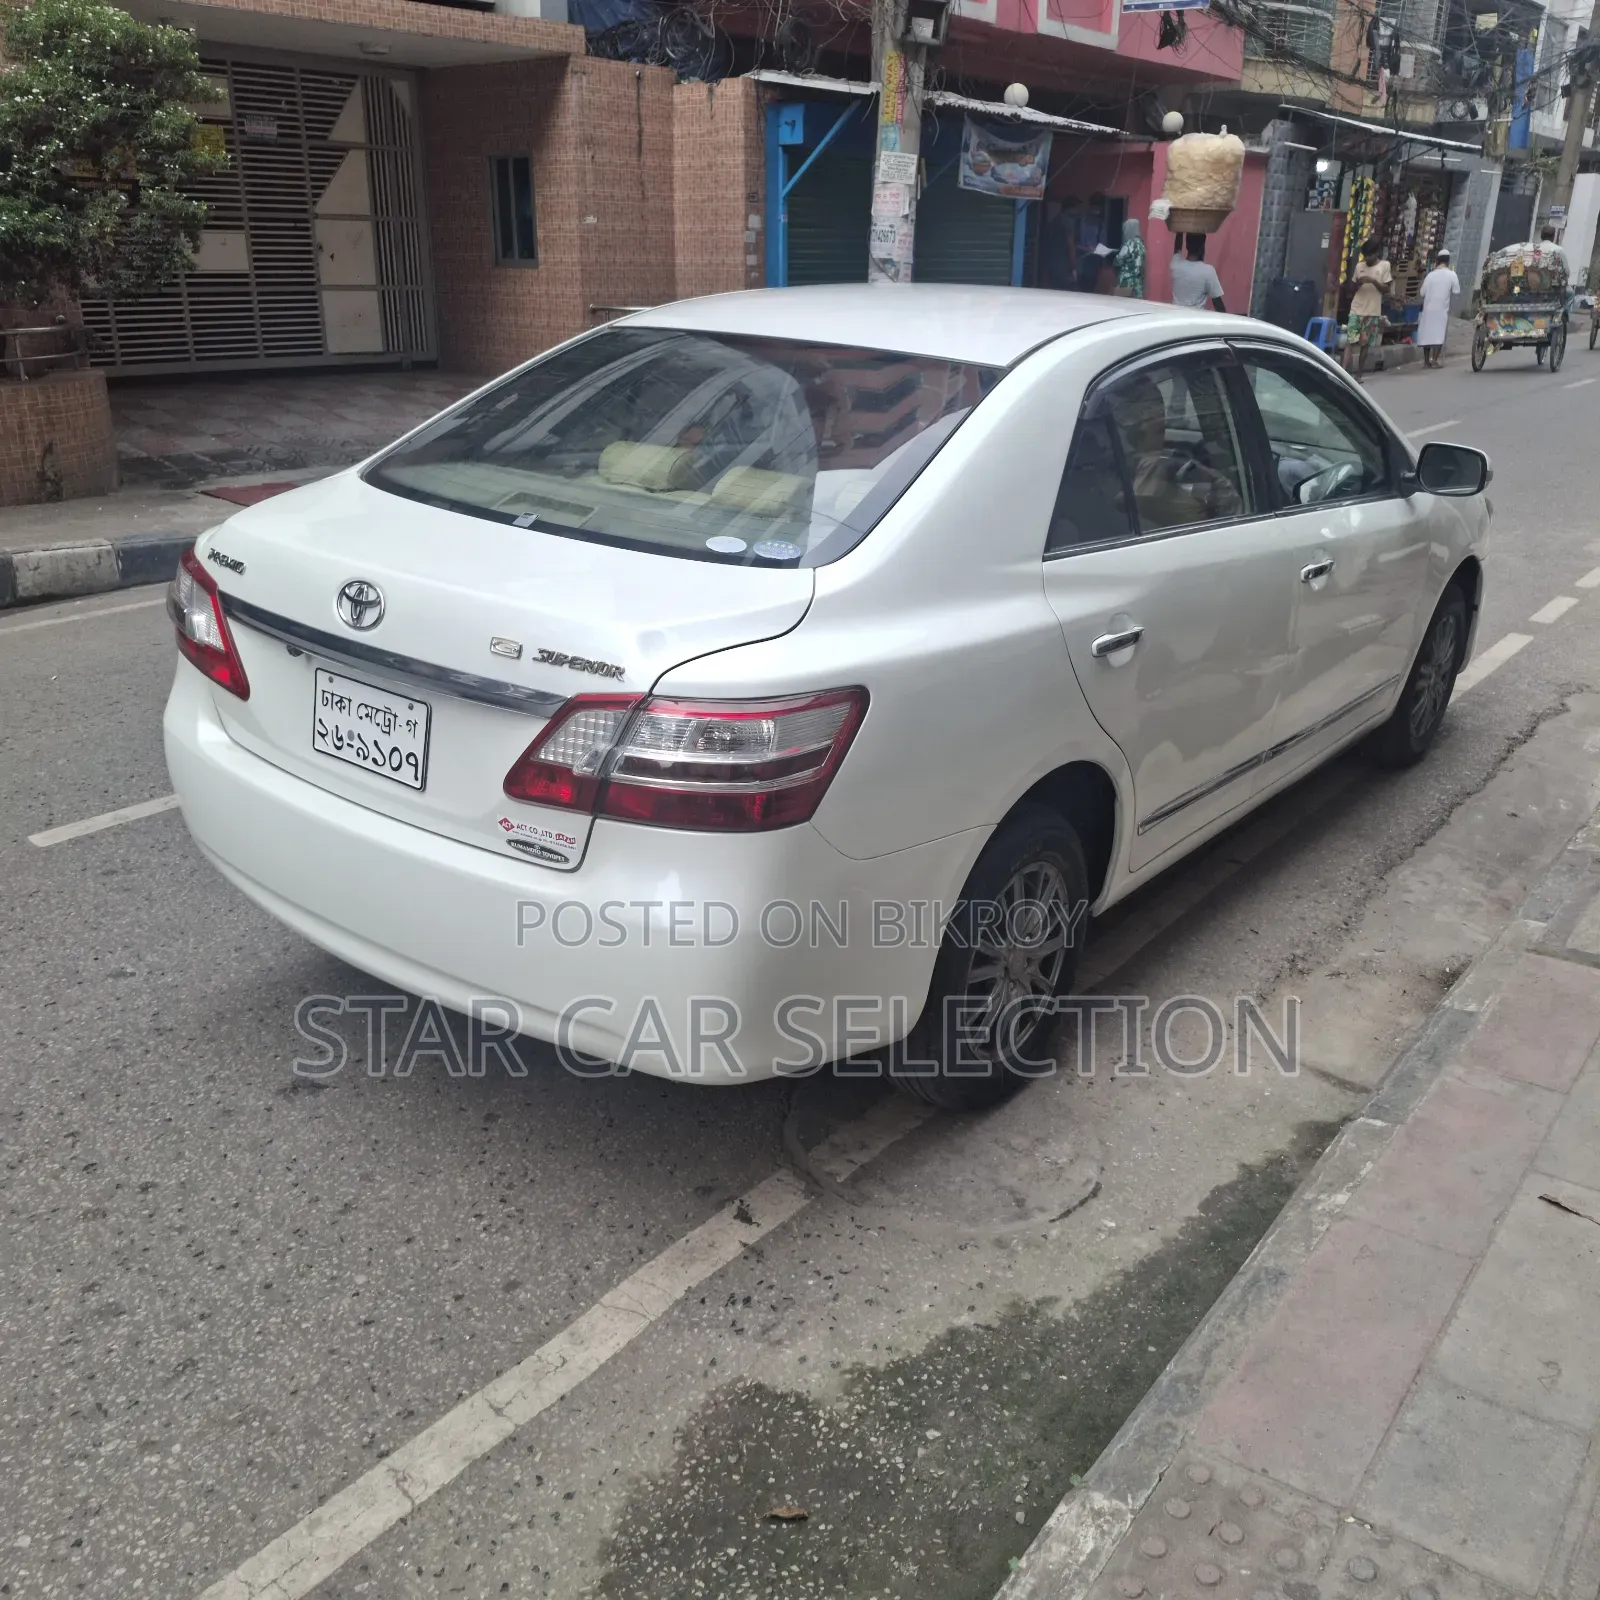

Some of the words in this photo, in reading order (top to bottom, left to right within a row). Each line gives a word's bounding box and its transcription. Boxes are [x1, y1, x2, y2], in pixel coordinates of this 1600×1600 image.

[208, 548, 246, 575] PREMIO
[532, 648, 625, 682] SUPERIOR
[321, 689, 352, 717] ঢাকা
[516, 823, 527, 831] ACT
[556, 833, 576, 844] JAPAN
[510, 841, 541, 855] KUMAMOTO
